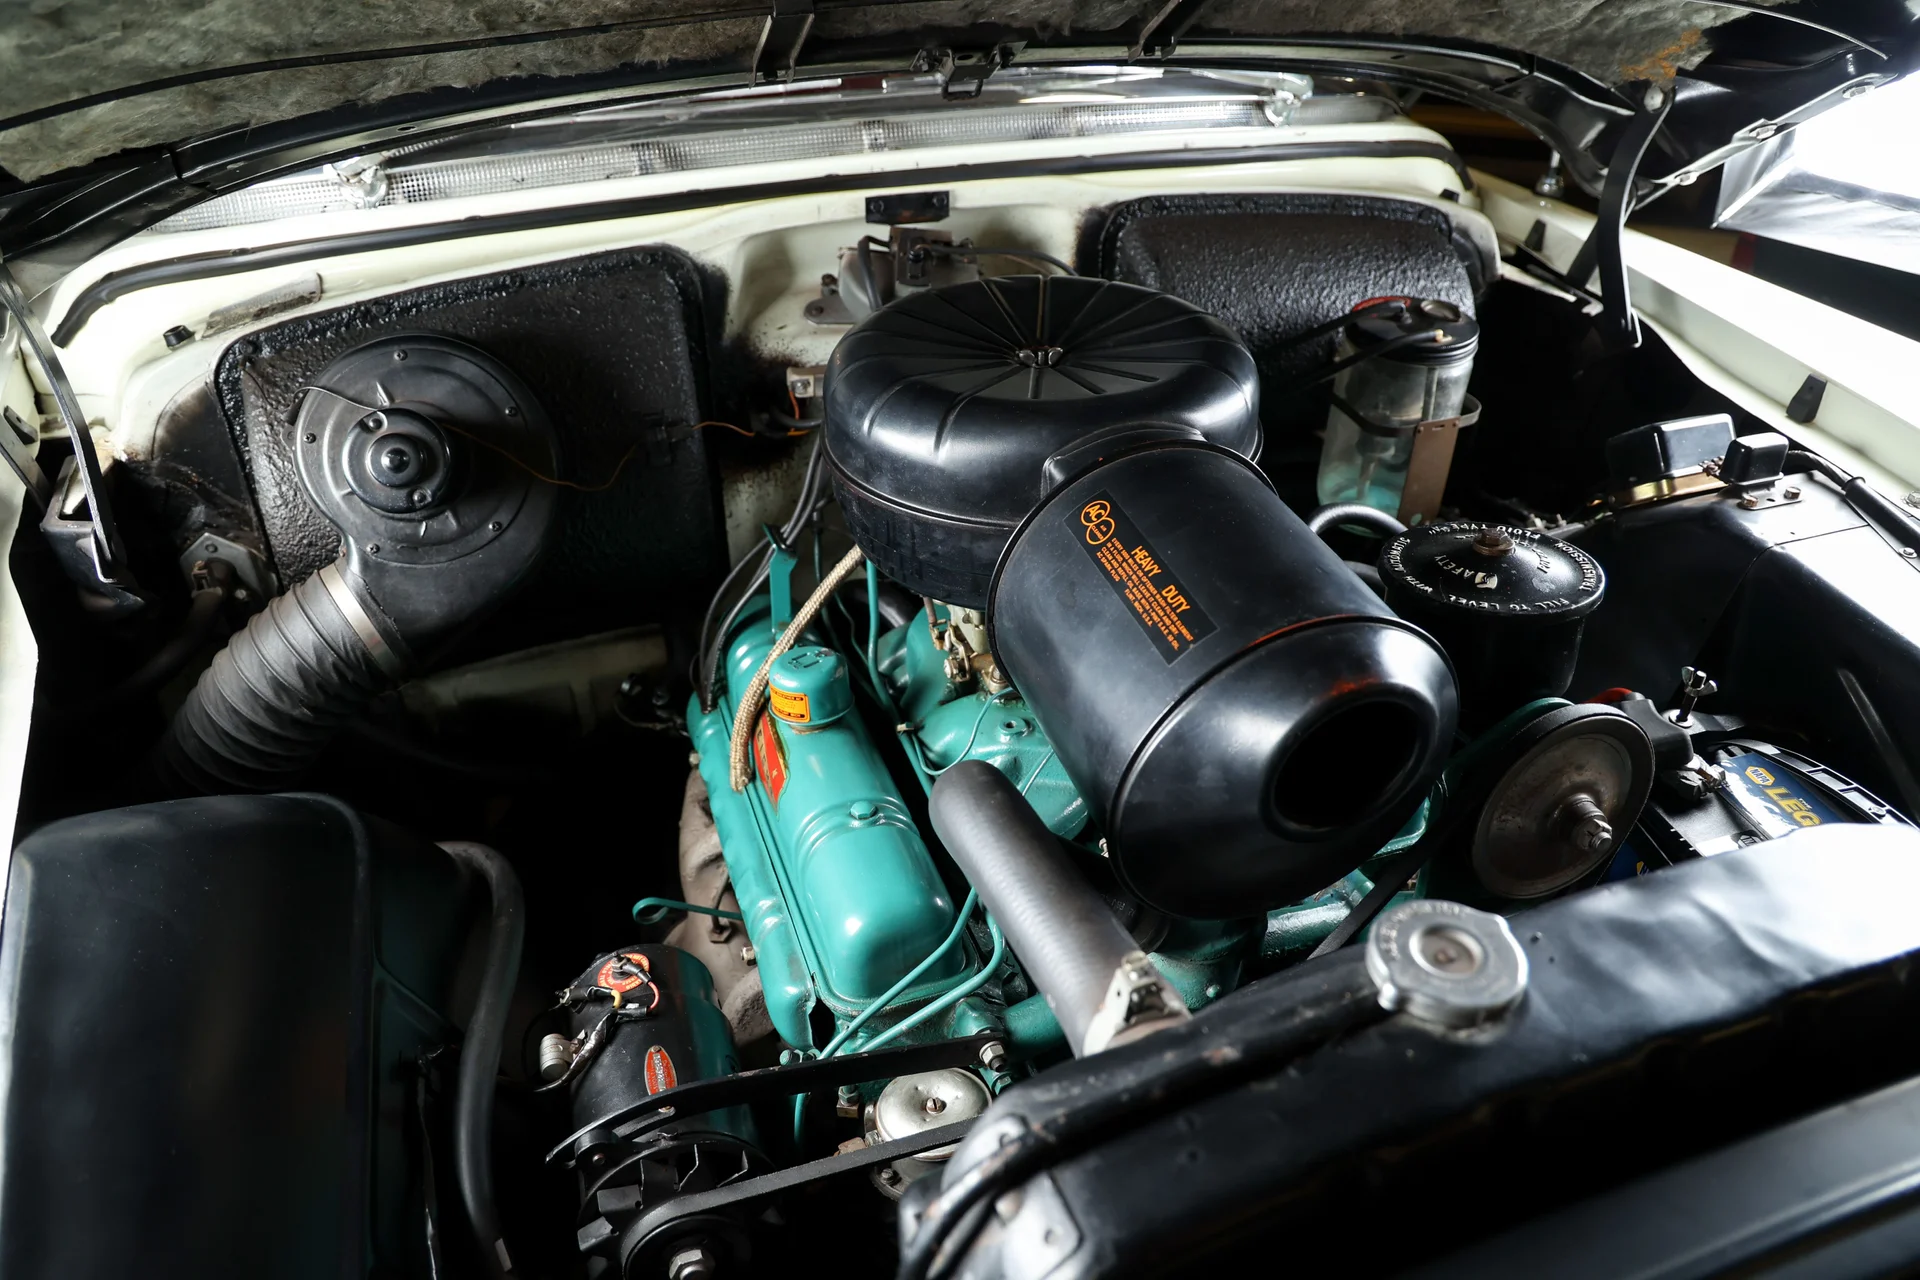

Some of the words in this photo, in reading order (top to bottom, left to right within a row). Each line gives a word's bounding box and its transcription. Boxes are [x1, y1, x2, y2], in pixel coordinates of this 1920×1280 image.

[1086, 505, 1105, 522] AC
[1387, 536, 1411, 573] AUTOMATIC
[1554, 541, 1598, 592] TRANSMISSION
[1100, 556, 1113, 572] SPARK
[1110, 569, 1120, 581] PLUG
[1101, 546, 1114, 561] CLEAN
[1109, 558, 1120, 569] AND
[1115, 566, 1129, 582] REFILL
[1139, 597, 1151, 611] WITH
[1131, 546, 1162, 577] HEAVY
[1161, 584, 1191, 613] DUTY
[1111, 538, 1124, 551] EVERY
[1127, 558, 1140, 572] MILES
[1135, 569, 1145, 578] OR
[1153, 593, 1168, 608] WASH
[1164, 605, 1179, 623] FILTER
[1174, 620, 1194, 641] ELEMENT
[1120, 562, 1135, 576] WHICH
[1131, 574, 1141, 586] WILL
[1137, 584, 1152, 600] LEAVE
[1150, 601, 1165, 619] CLEAN
[1160, 615, 1173, 627] AND
[1403, 576, 1433, 594] WITH
[1449, 594, 1500, 611] LEVEL
[1509, 603, 1531, 611] TO
[1535, 597, 1570, 610] FILL
[1749, 768, 1771, 784] NAPA
